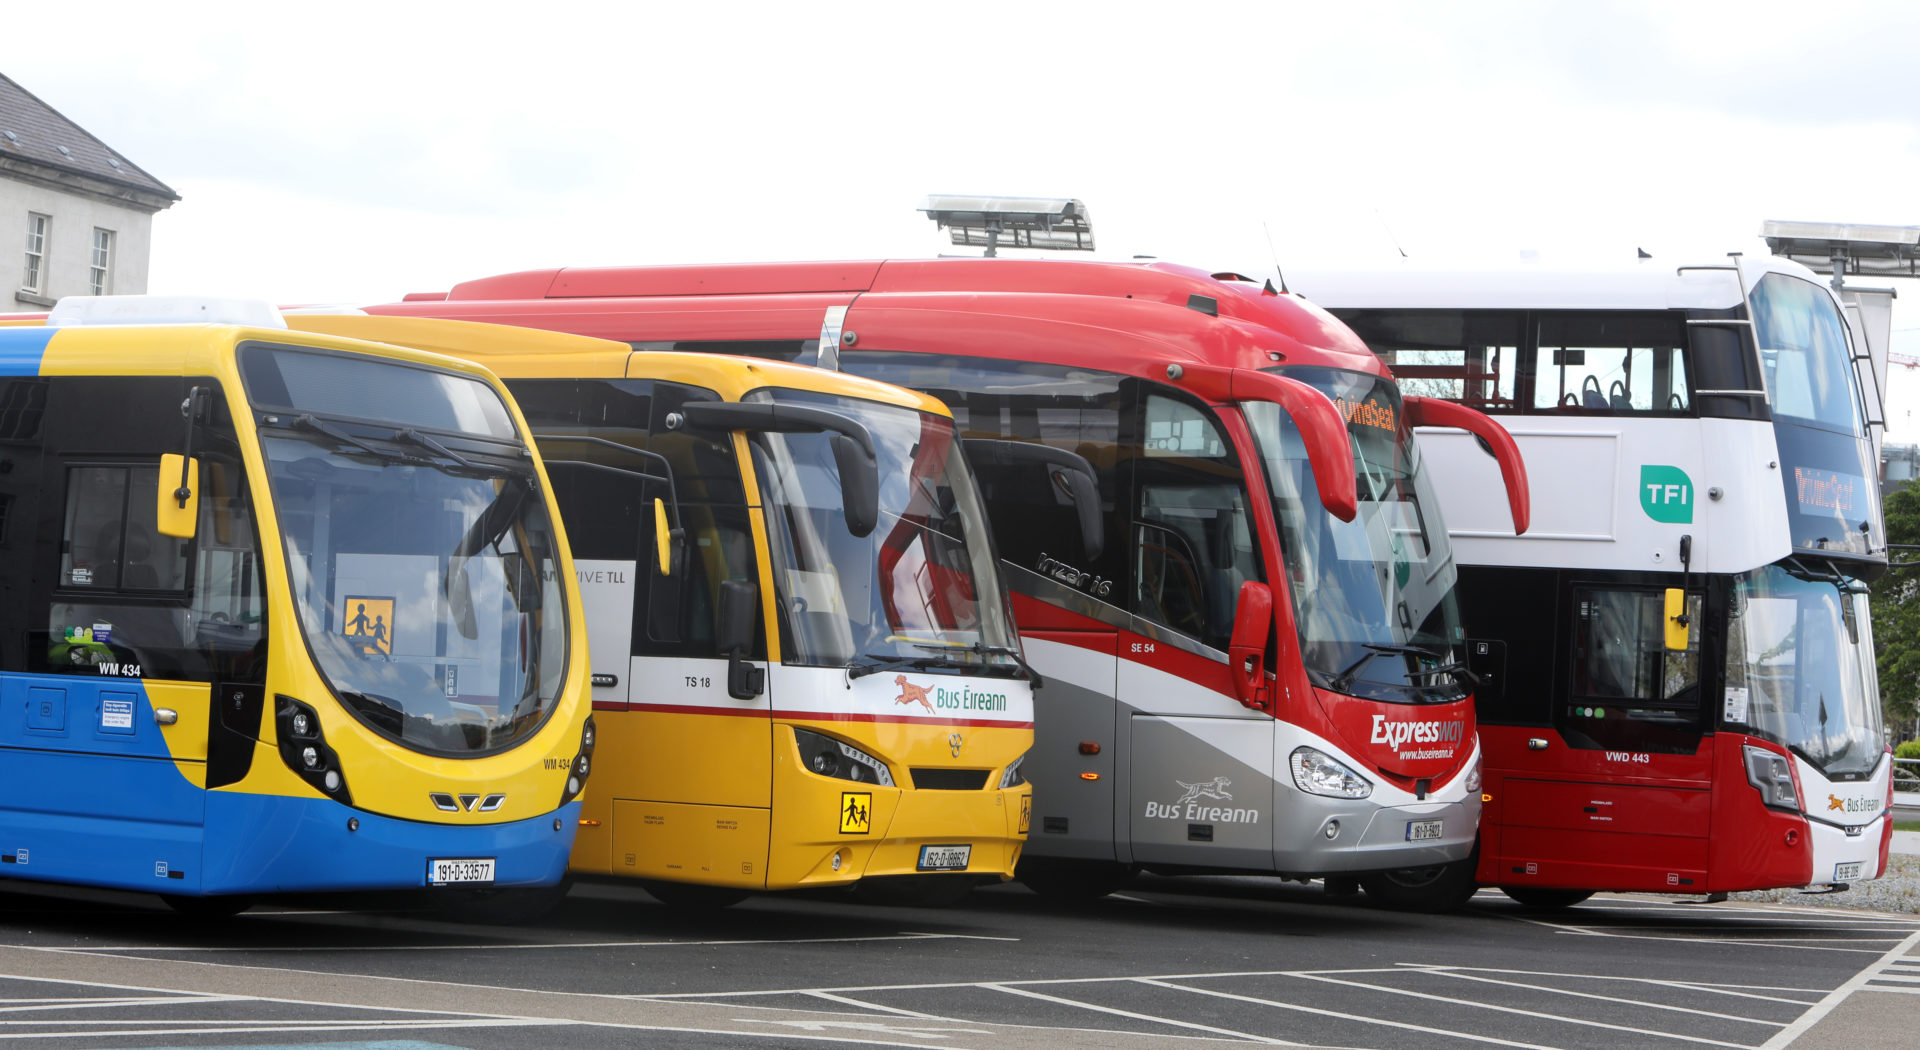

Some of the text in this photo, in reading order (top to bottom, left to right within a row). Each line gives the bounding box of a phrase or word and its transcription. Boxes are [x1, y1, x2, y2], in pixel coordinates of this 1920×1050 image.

[1333, 393, 1396, 432] ivingSeat
[1647, 484, 1687, 504] TFI
[607, 571, 626, 583] TLL
[1131, 643, 1155, 653] SE 54
[99, 662, 141, 677] WM 434
[685, 676, 710, 688] TS 18
[937, 688, 960, 709] Bus
[1370, 715, 1465, 752] Expressway
[1400, 746, 1454, 760] www.buseireann.ie
[1606, 751, 1650, 763] VWD 443
[544, 758, 570, 770] WM 434
[1145, 801, 1181, 819] Bus
[1847, 798, 1859, 812] Bus
[438, 863, 490, 881] 191-D-33577
